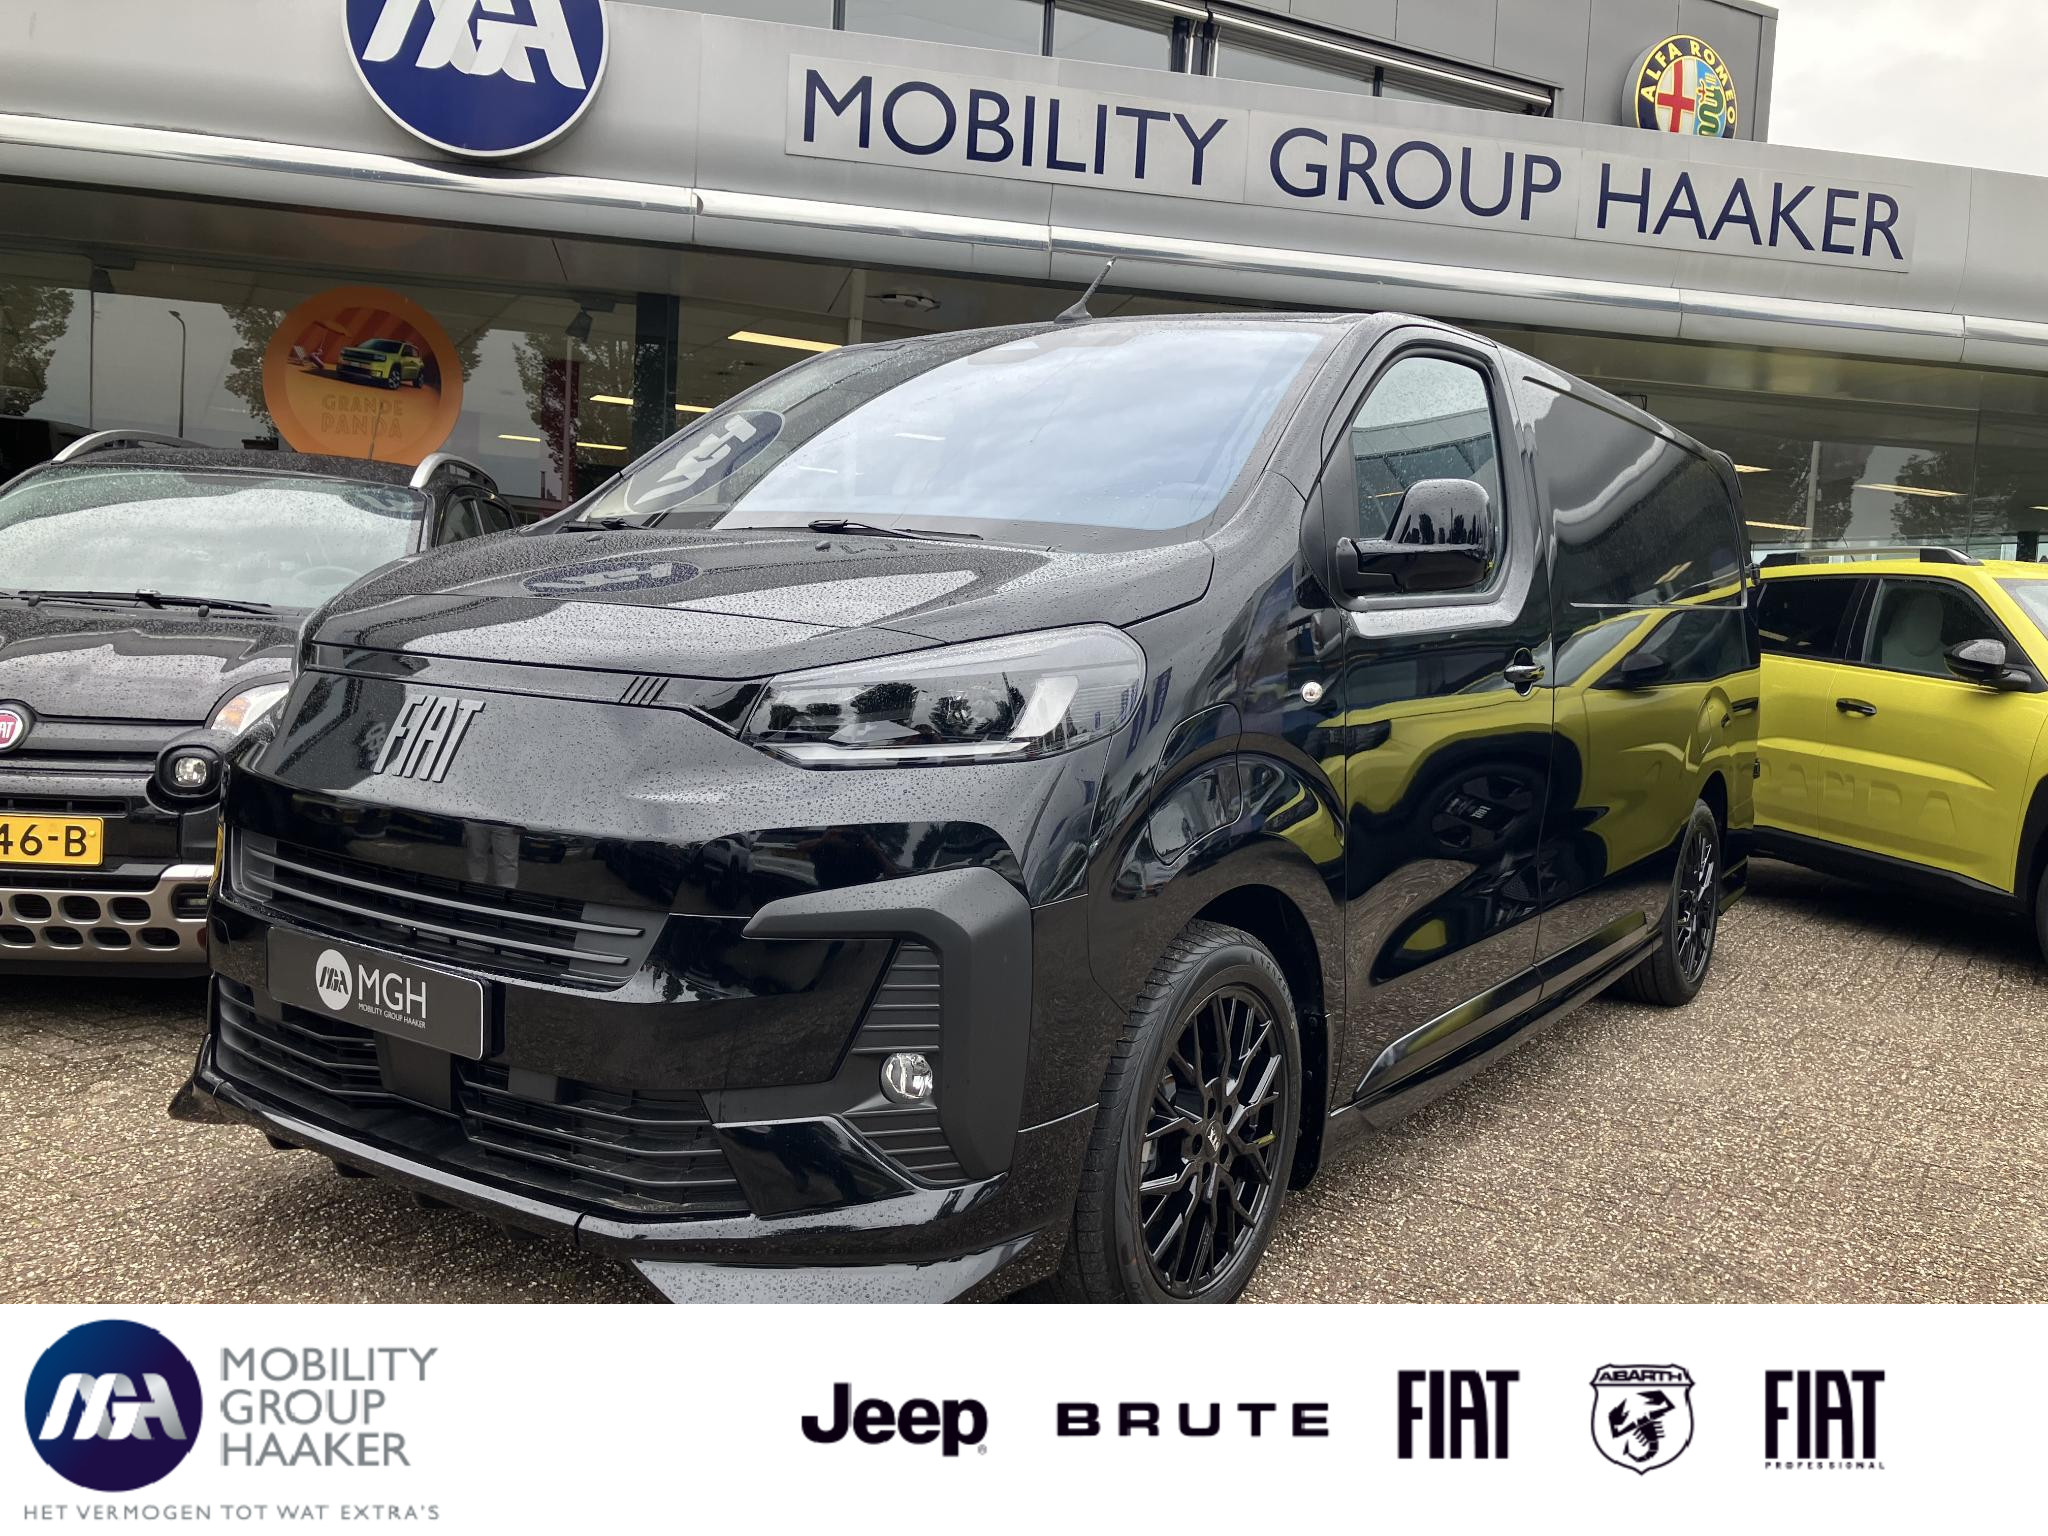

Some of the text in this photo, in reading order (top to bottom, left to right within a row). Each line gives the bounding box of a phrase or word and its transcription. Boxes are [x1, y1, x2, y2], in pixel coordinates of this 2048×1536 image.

[1640, 39, 1736, 124] ALFA ROMEO
[803, 69, 1904, 261] MOBILITY GROUP HAAKER
[321, 393, 403, 416] GRANDE
[321, 411, 402, 438] PANDA
[373, 695, 486, 783] FIAT
[358, 964, 427, 1019] MGH
[358, 1002, 426, 1029] MOBILITY GROUP HAAKER
